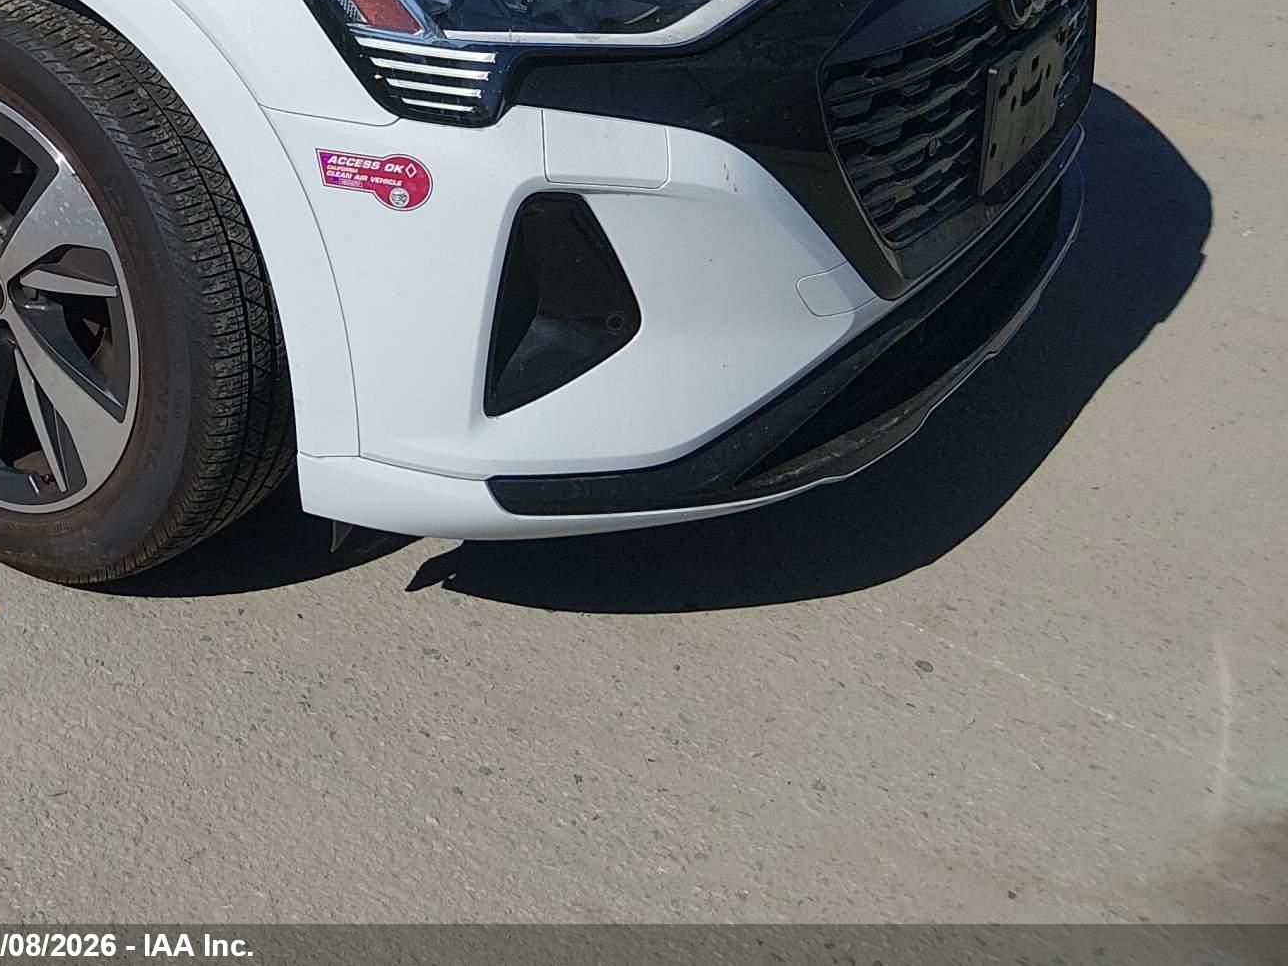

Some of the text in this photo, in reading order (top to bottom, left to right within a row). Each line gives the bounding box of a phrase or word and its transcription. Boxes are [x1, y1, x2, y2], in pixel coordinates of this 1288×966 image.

[326, 164, 359, 173] CALIFORNIA
[327, 155, 405, 174] ACCESS OK
[326, 170, 352, 179] CLEAN
[370, 176, 403, 187] VEHICLE
